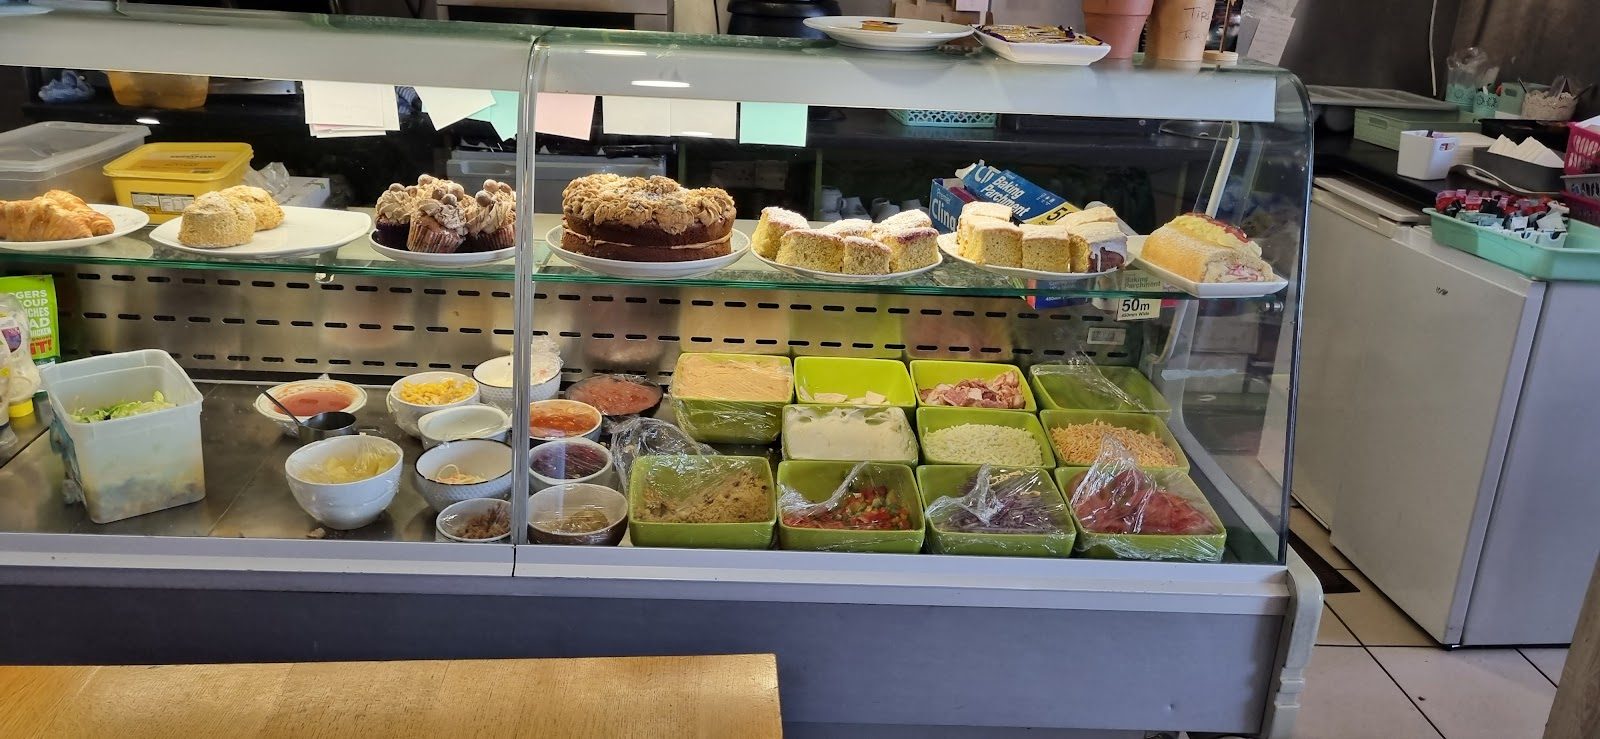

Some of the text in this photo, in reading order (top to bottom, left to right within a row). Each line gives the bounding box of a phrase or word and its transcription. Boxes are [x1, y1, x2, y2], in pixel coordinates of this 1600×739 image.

[992, 175, 1025, 200] Baking
[980, 184, 1031, 217] Parchment
[931, 198, 957, 231] Cling
[8, 289, 47, 299] GERS
[20, 298, 48, 308] OUP
[1121, 298, 1150, 312] 50m
[25, 307, 49, 318] CHES
[29, 318, 50, 329] AD
